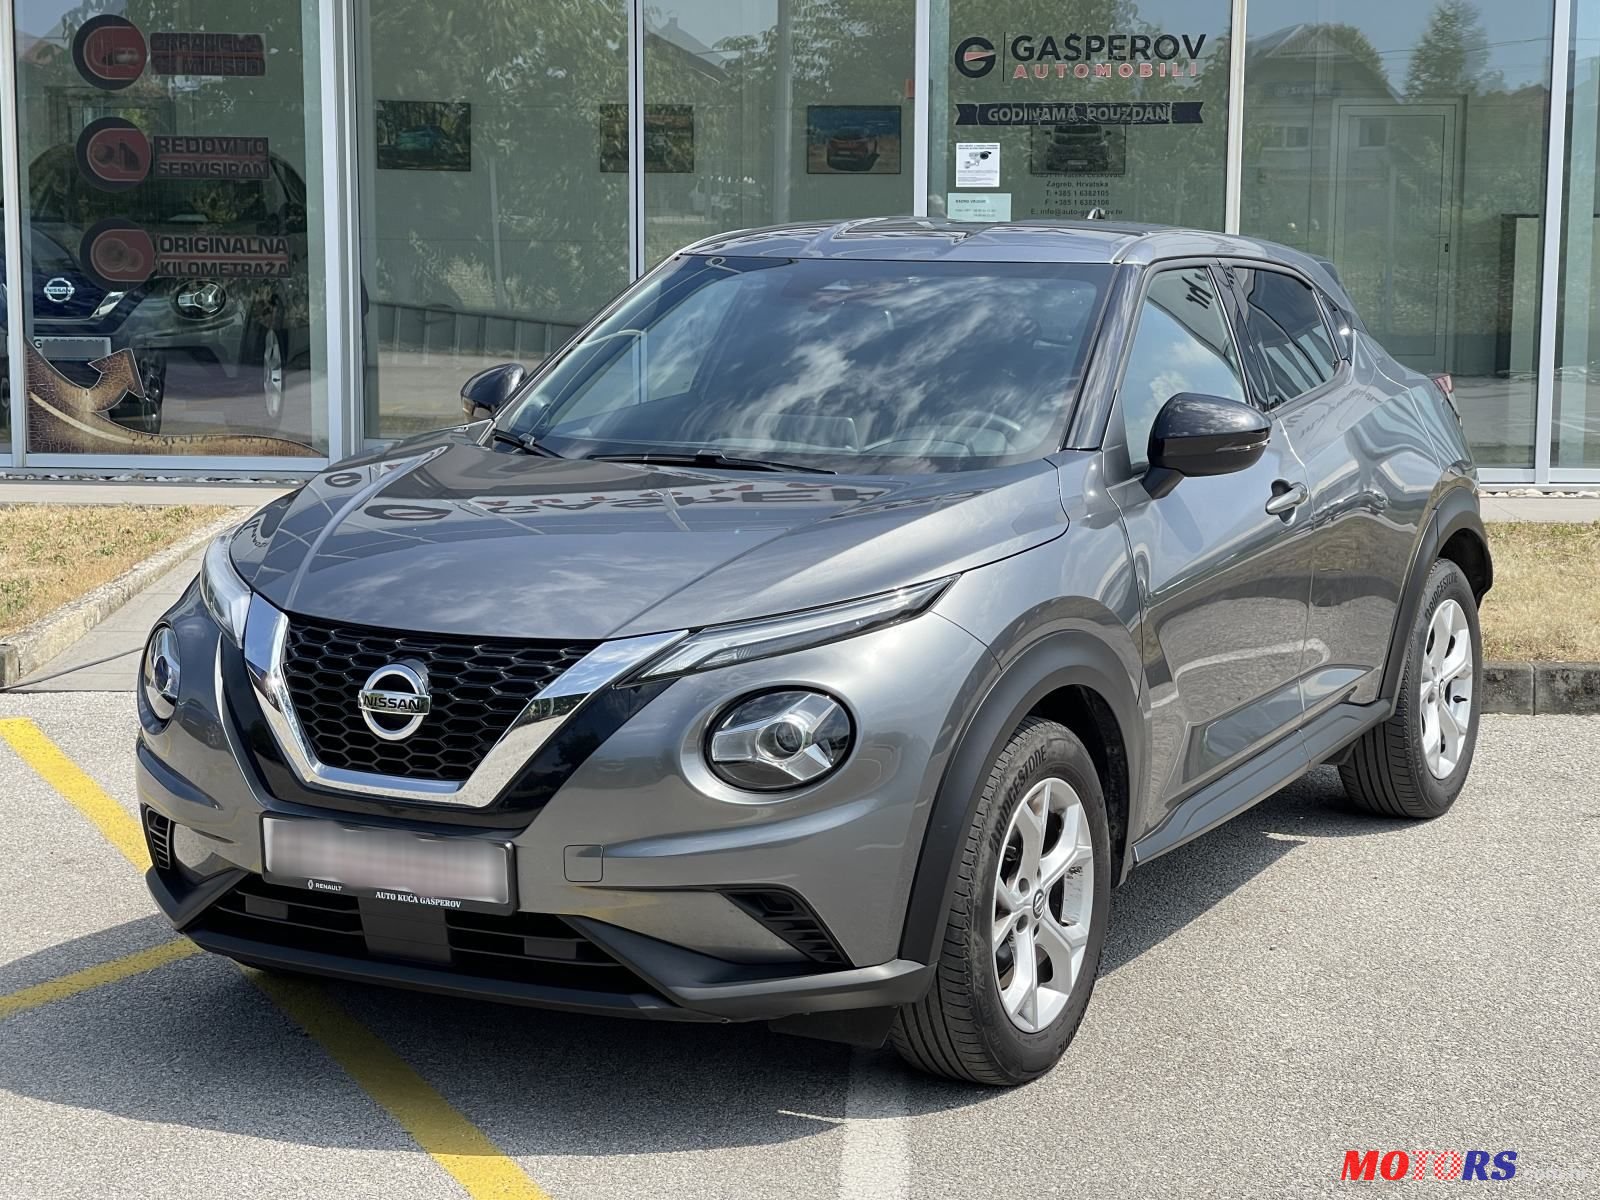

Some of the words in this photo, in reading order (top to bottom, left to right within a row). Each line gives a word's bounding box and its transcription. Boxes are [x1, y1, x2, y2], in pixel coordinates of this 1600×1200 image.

[1011, 33, 1207, 61] GAŠPEROV
[1013, 63, 1197, 79] AUTOMOBILI
[988, 107, 1078, 121] GODINAMA
[159, 138, 265, 154] REDOVITO
[159, 161, 267, 176] SERVISIRAN
[160, 236, 288, 253] ORIGINALNA
[160, 260, 289, 276] KILOMETRAŽA
[363, 695, 420, 710] NISSAN
[988, 744, 1047, 856] BRIDGESTONE
[315, 882, 343, 891] RENAULT
[375, 891, 396, 900] AUTO
[397, 893, 418, 904] KUĆA
[419, 897, 461, 908] GAŠPEROV
